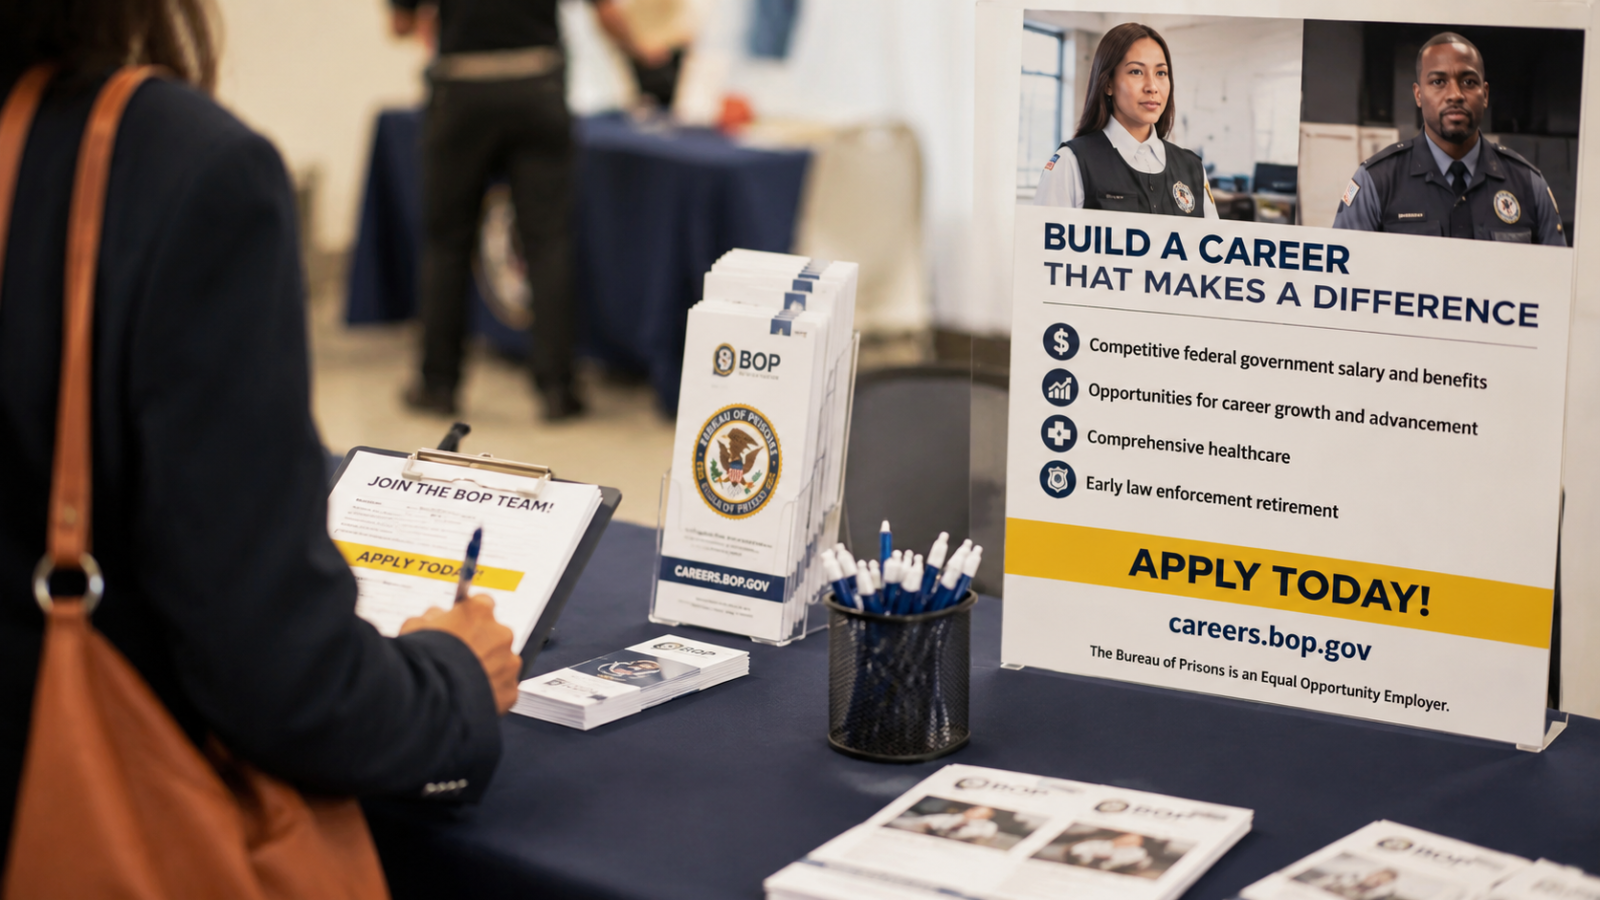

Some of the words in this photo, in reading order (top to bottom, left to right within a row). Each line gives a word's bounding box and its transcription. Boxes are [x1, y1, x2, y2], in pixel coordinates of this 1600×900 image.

[1044, 222, 1151, 257] BUILD
[1161, 232, 1188, 261] A
[1198, 234, 1350, 275] CAREER
[1043, 261, 1133, 292] THAT
[1144, 269, 1266, 304] MAKES
[1276, 281, 1302, 307] A
[1313, 284, 1539, 329] DIFFERENCE
[738, 349, 782, 373] BOP
[1089, 337, 1180, 360] Competitive
[1183, 345, 1237, 365] federal
[1239, 353, 1335, 375] government
[1337, 361, 1386, 383] salary
[1388, 367, 1419, 384] and
[1422, 368, 1488, 390] benefits
[733, 409, 747, 421] OF
[1088, 382, 1193, 407] Opportunities
[1195, 392, 1219, 409] for
[1221, 398, 1272, 414] career
[1274, 404, 1331, 421] growth
[1334, 408, 1366, 424] and
[1369, 411, 1479, 436] advancement
[1087, 429, 1205, 455] Comprehensive
[1208, 440, 1291, 465] healthcare
[367, 476, 412, 492] JOIN
[416, 482, 452, 499] THE
[453, 489, 493, 505] BOP
[497, 496, 555, 513] TEAM!
[1086, 475, 1124, 497] Early
[1126, 480, 1153, 498] law
[1156, 484, 1253, 509] enforcement
[1256, 497, 1340, 519] retirement
[356, 551, 415, 570] APPLY
[418, 560, 485, 581] TODA!
[674, 564, 770, 593] CAREERS.BOP.GOV
[1128, 548, 1262, 592] APPLY
[1272, 565, 1431, 617] TODAY!
[1168, 615, 1373, 662] careers.bop.gov
[1089, 644, 1113, 660] The
[1115, 648, 1160, 667] Bureau
[1162, 655, 1177, 670] of
[1179, 657, 1226, 677] Prisons
[1228, 665, 1239, 679] is
[1241, 669, 1258, 682] an
[1261, 670, 1297, 689] Equal
[1300, 677, 1381, 704] Opportunity
[1384, 689, 1450, 713] Employer.
